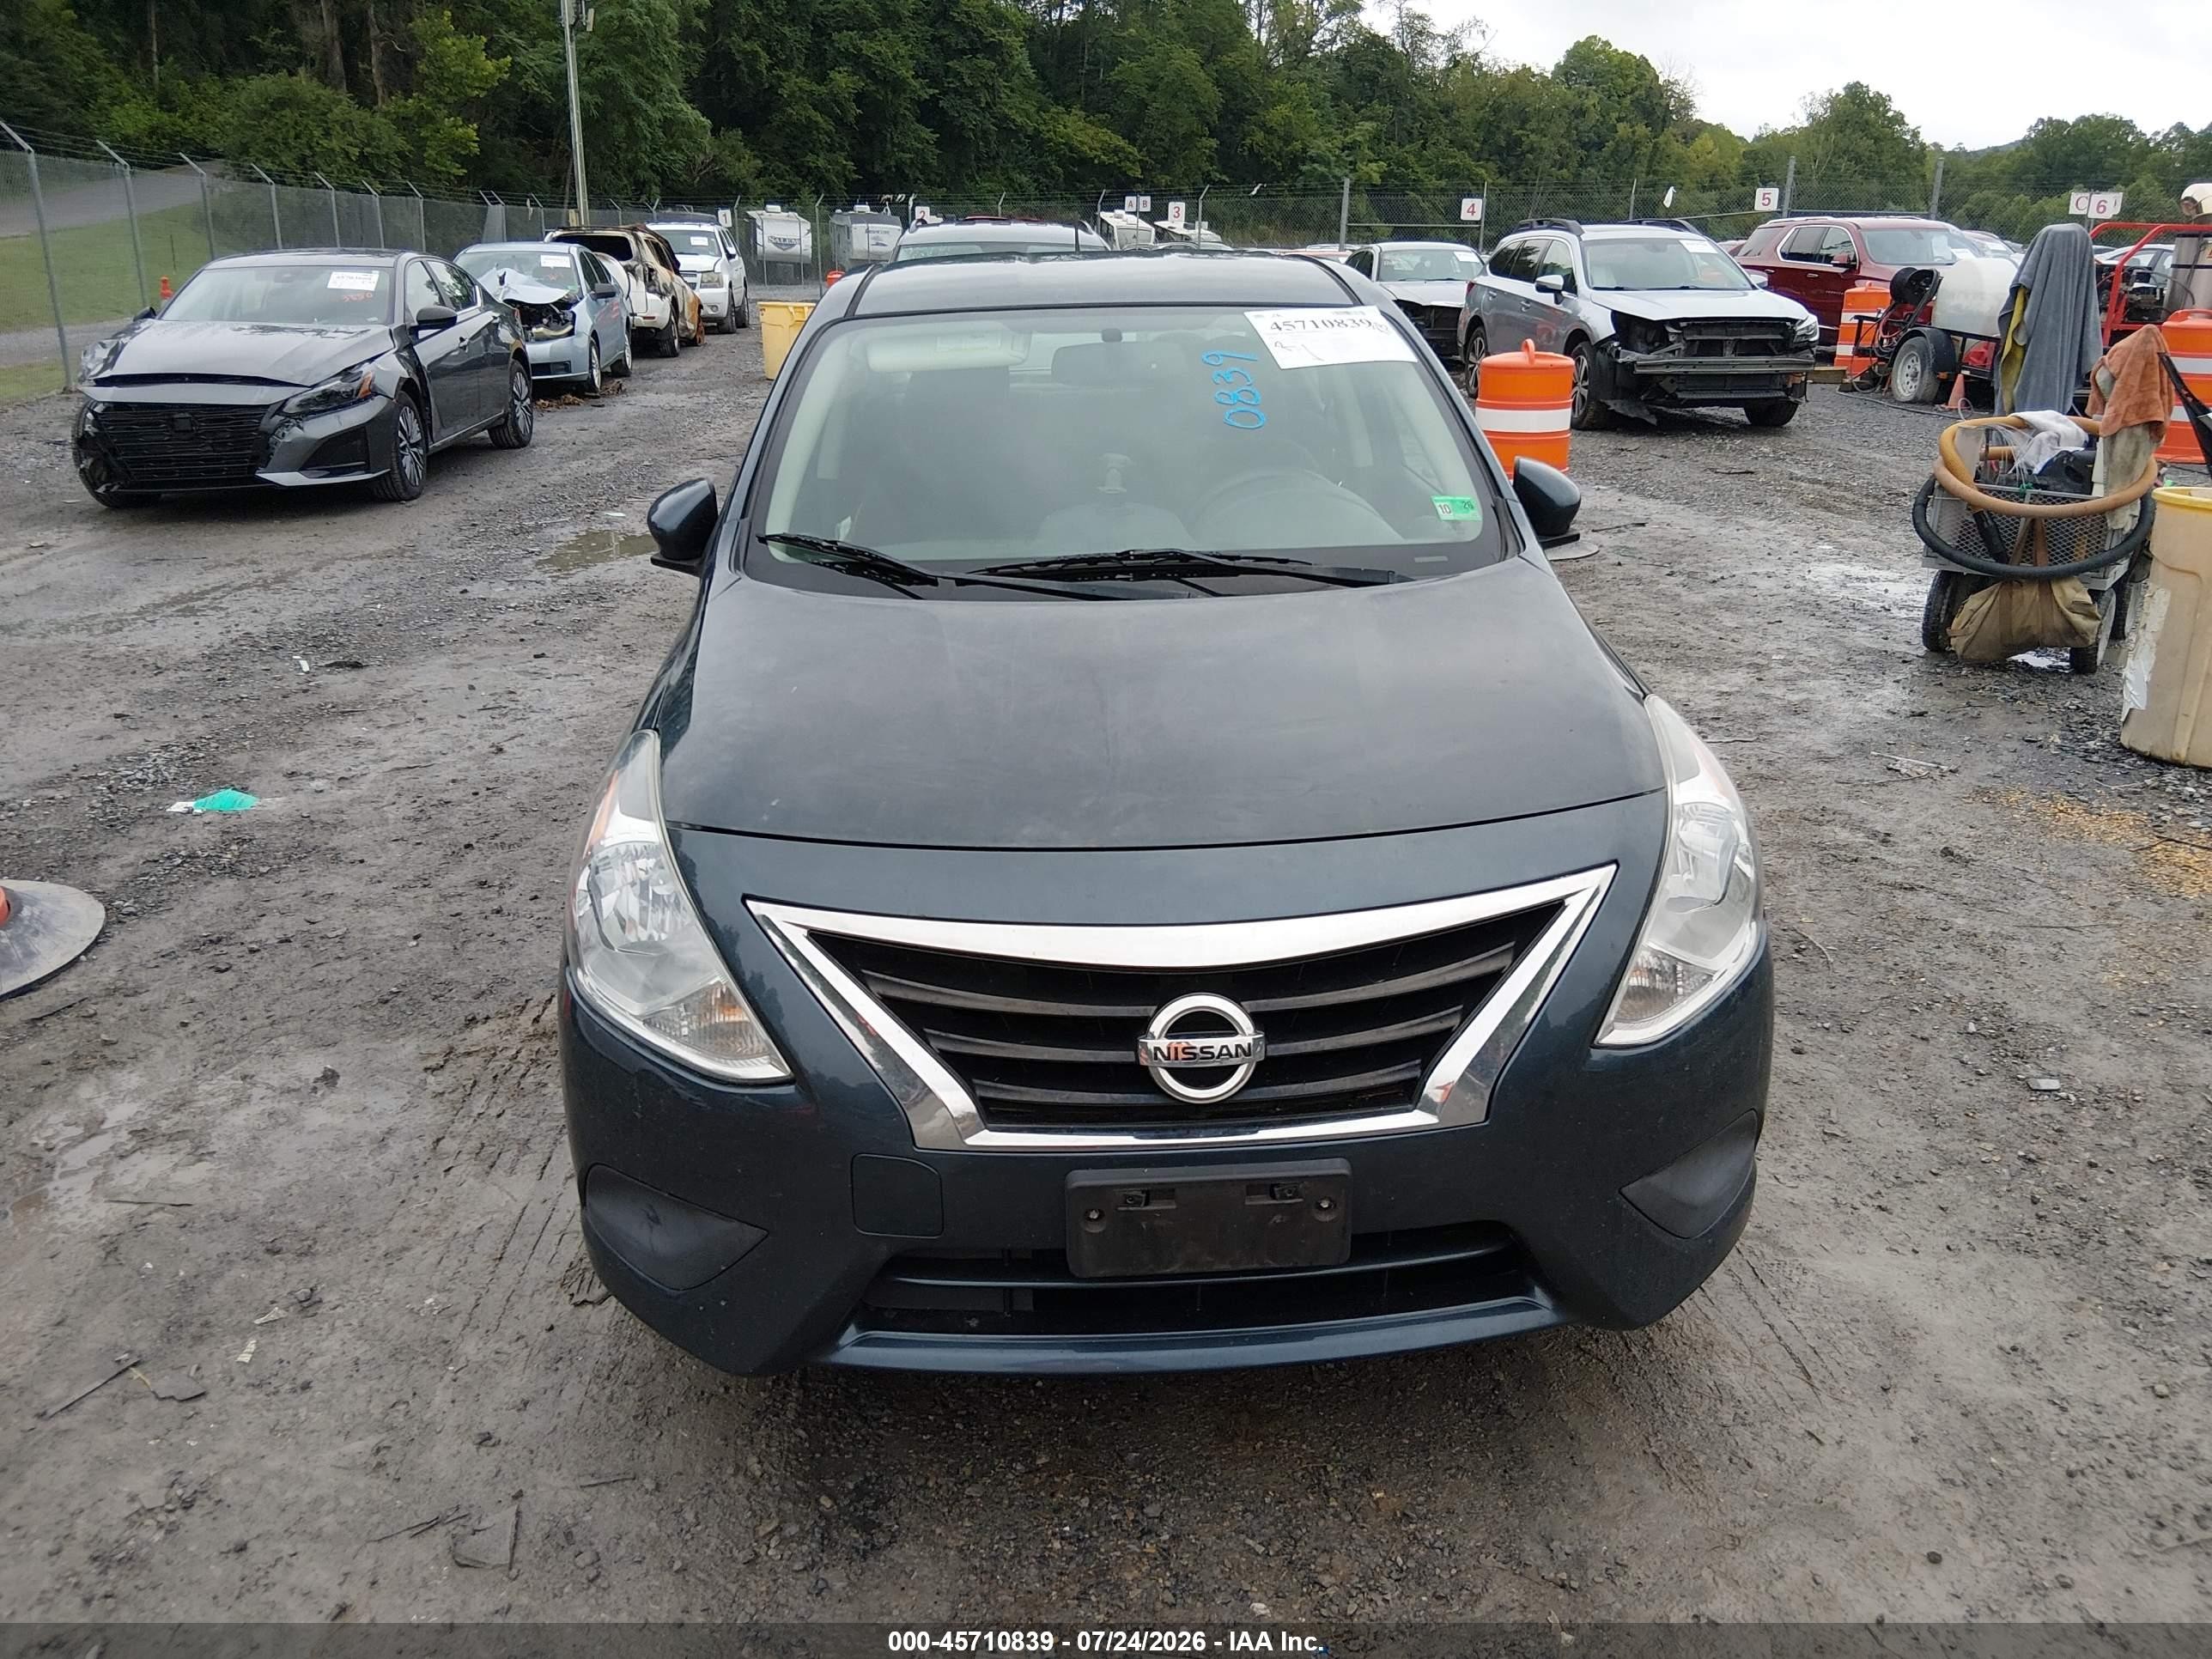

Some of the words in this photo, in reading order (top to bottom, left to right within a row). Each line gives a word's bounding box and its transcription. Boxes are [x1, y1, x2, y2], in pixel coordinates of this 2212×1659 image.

[1761, 192, 1771, 206] 5
[1173, 206, 1181, 218] 3
[1467, 203, 1476, 216] 4
[2096, 199, 2108, 214] 6
[722, 214, 727, 224] 1
[1270, 319, 1372, 331] 45710839
[1201, 350, 1266, 430] 0839
[1438, 503, 1451, 514] 10
[1153, 1042, 1251, 1061] NISSAN
